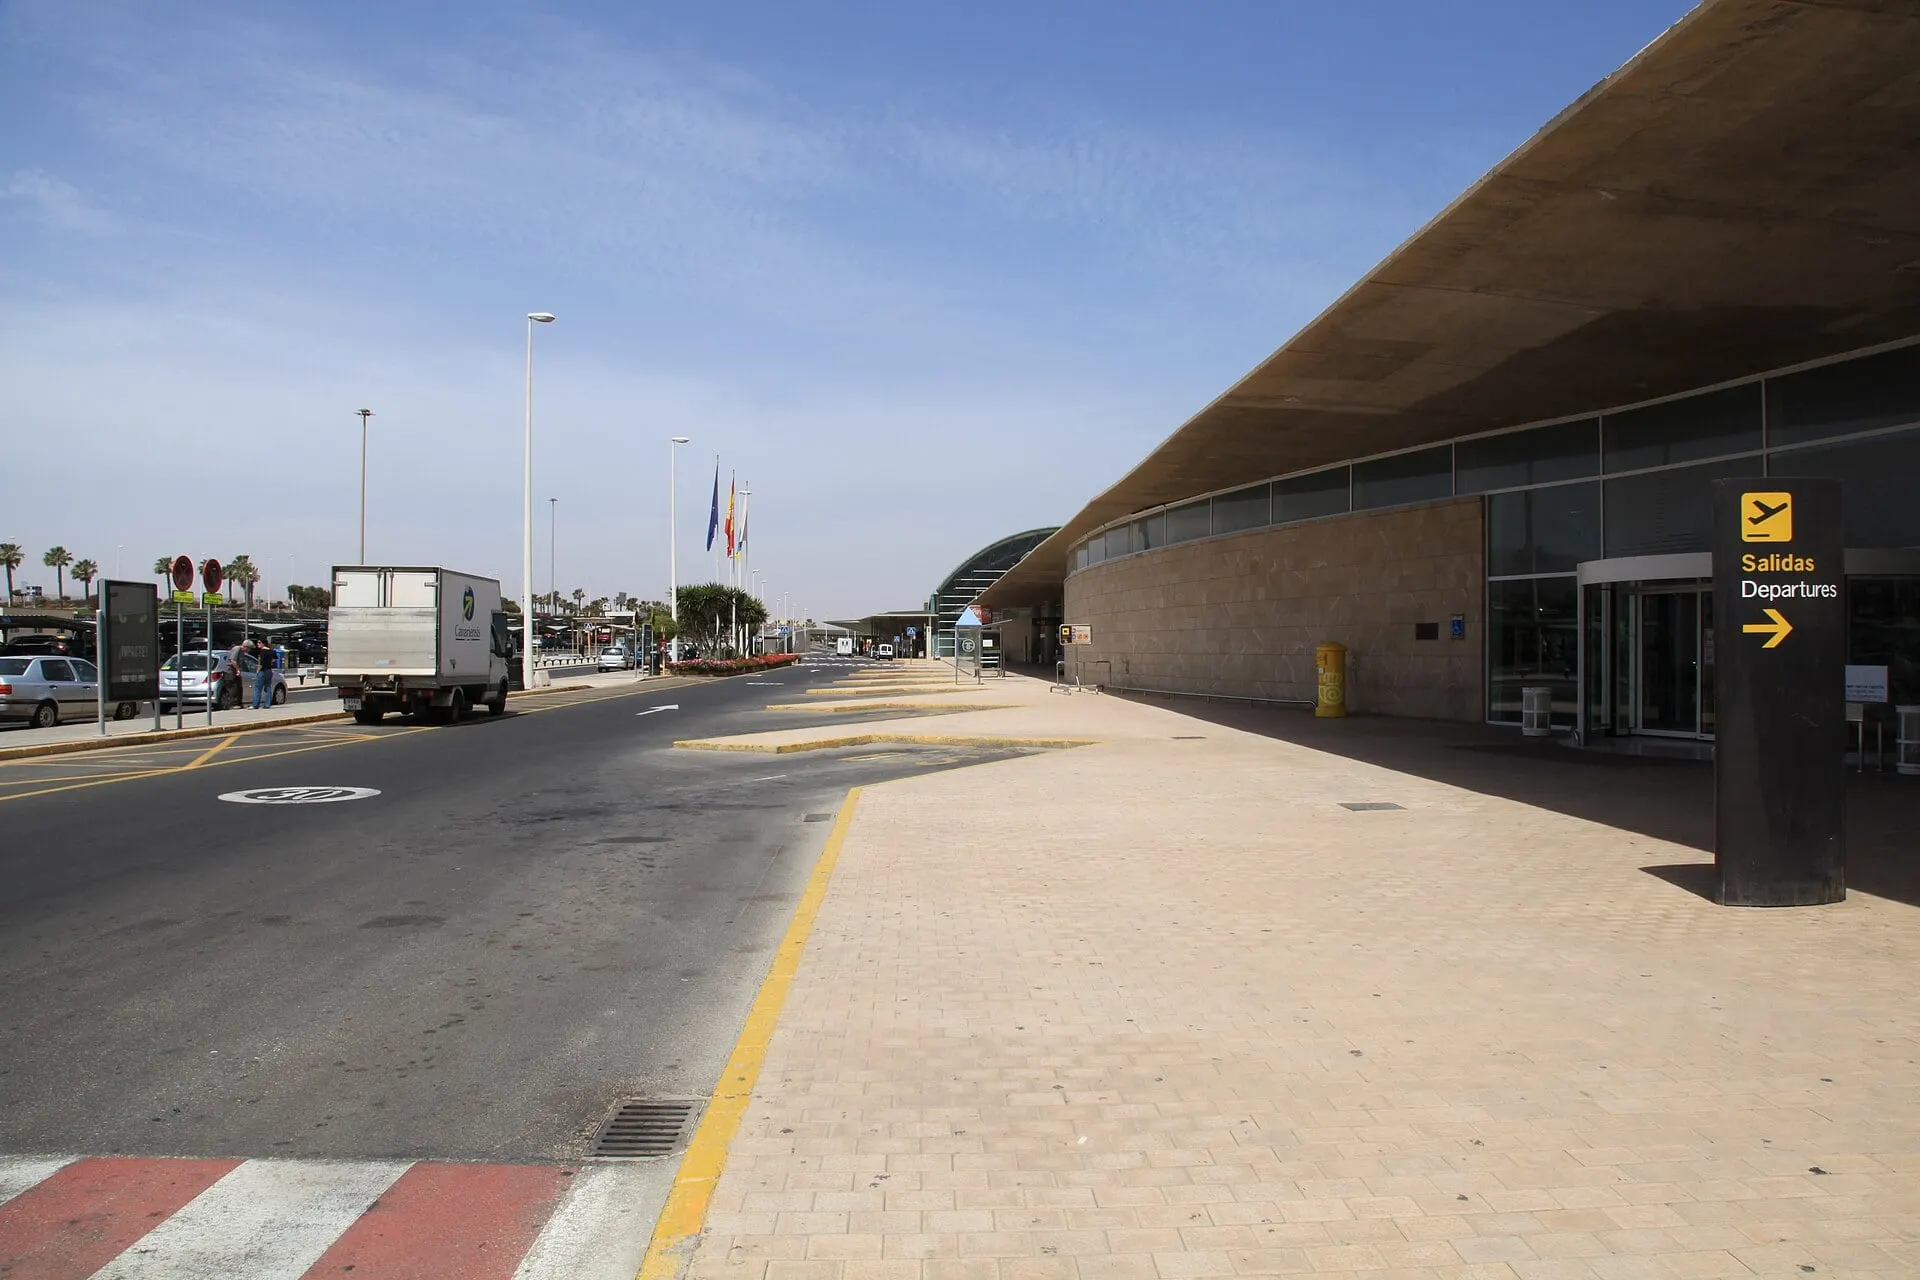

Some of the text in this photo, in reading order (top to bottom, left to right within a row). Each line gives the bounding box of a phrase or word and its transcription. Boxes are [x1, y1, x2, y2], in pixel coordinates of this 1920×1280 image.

[1741, 553, 1815, 572] Salidas
[1741, 580, 1837, 601] Departures
[256, 789, 343, 800] 30
